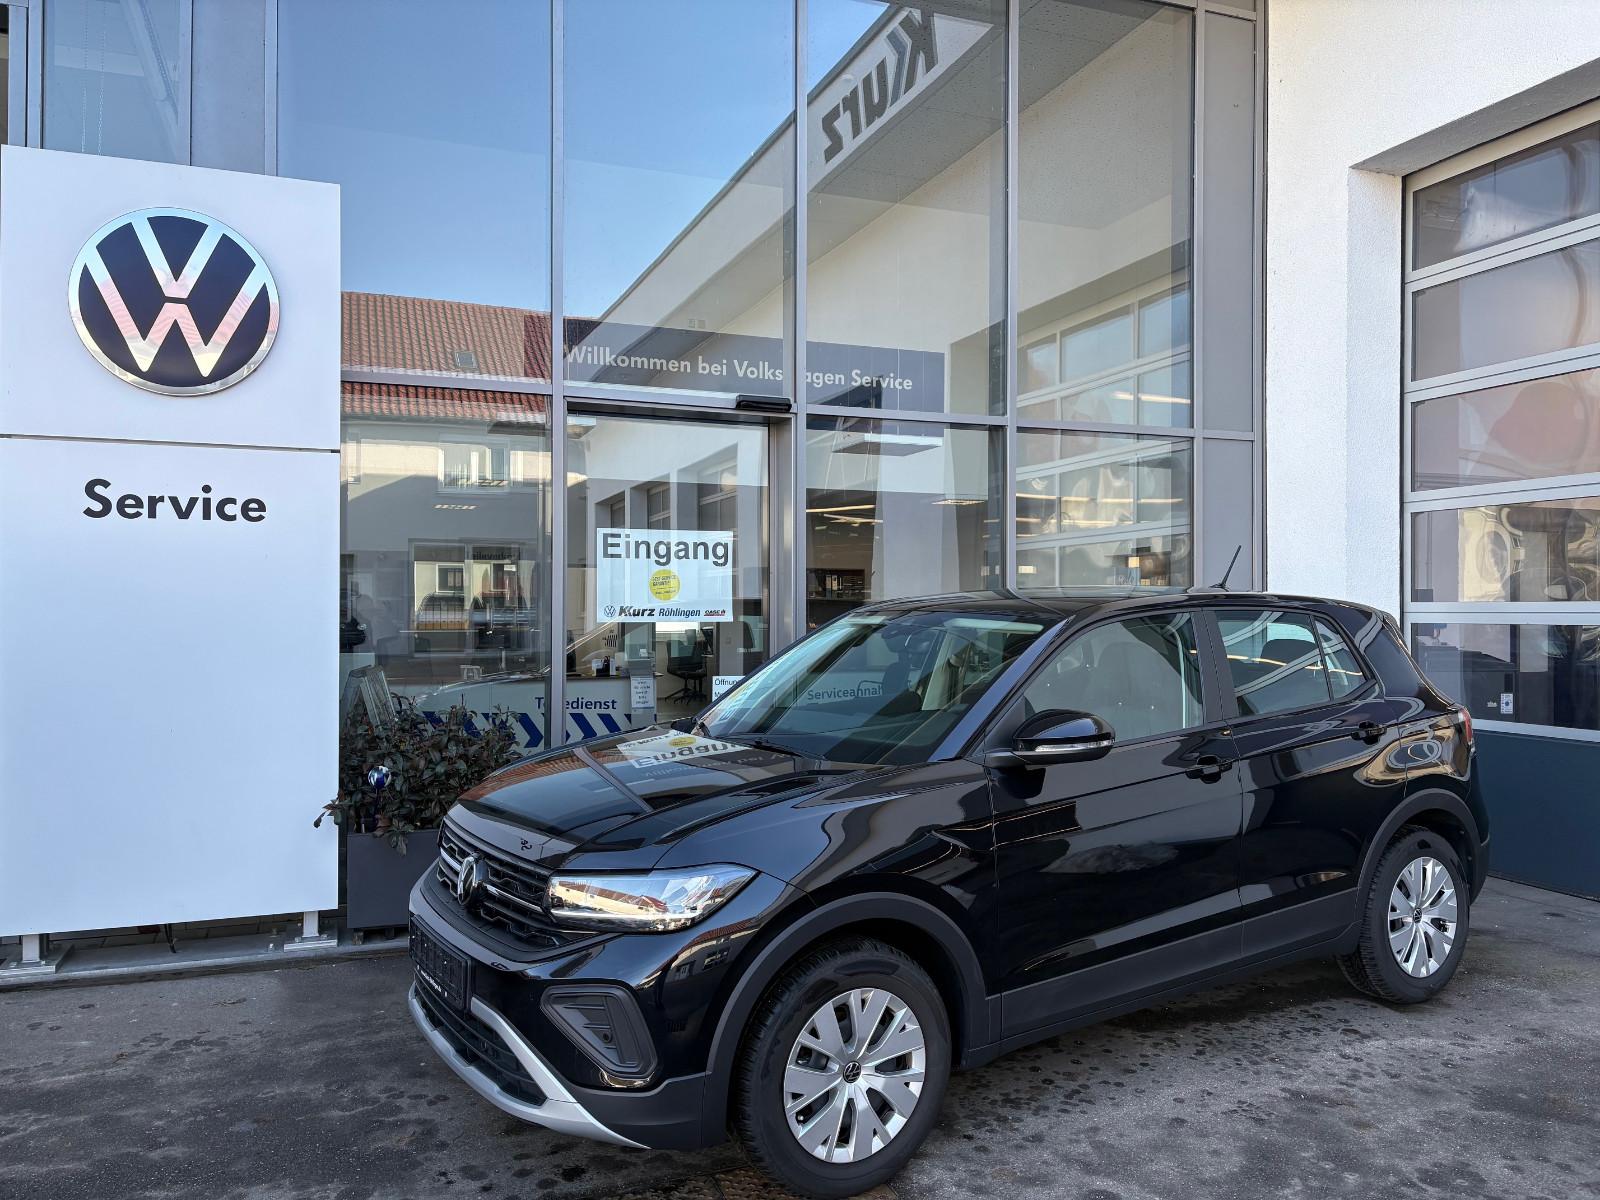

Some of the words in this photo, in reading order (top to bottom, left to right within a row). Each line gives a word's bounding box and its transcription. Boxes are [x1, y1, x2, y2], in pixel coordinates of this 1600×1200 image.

[567, 345, 691, 373] Willkommen
[698, 356, 727, 376] bei
[733, 360, 845, 388] Volksagen
[851, 368, 913, 390] Service
[82, 478, 267, 523] Service
[602, 532, 729, 567] Eingang
[658, 607, 701, 619] Röhlingen
